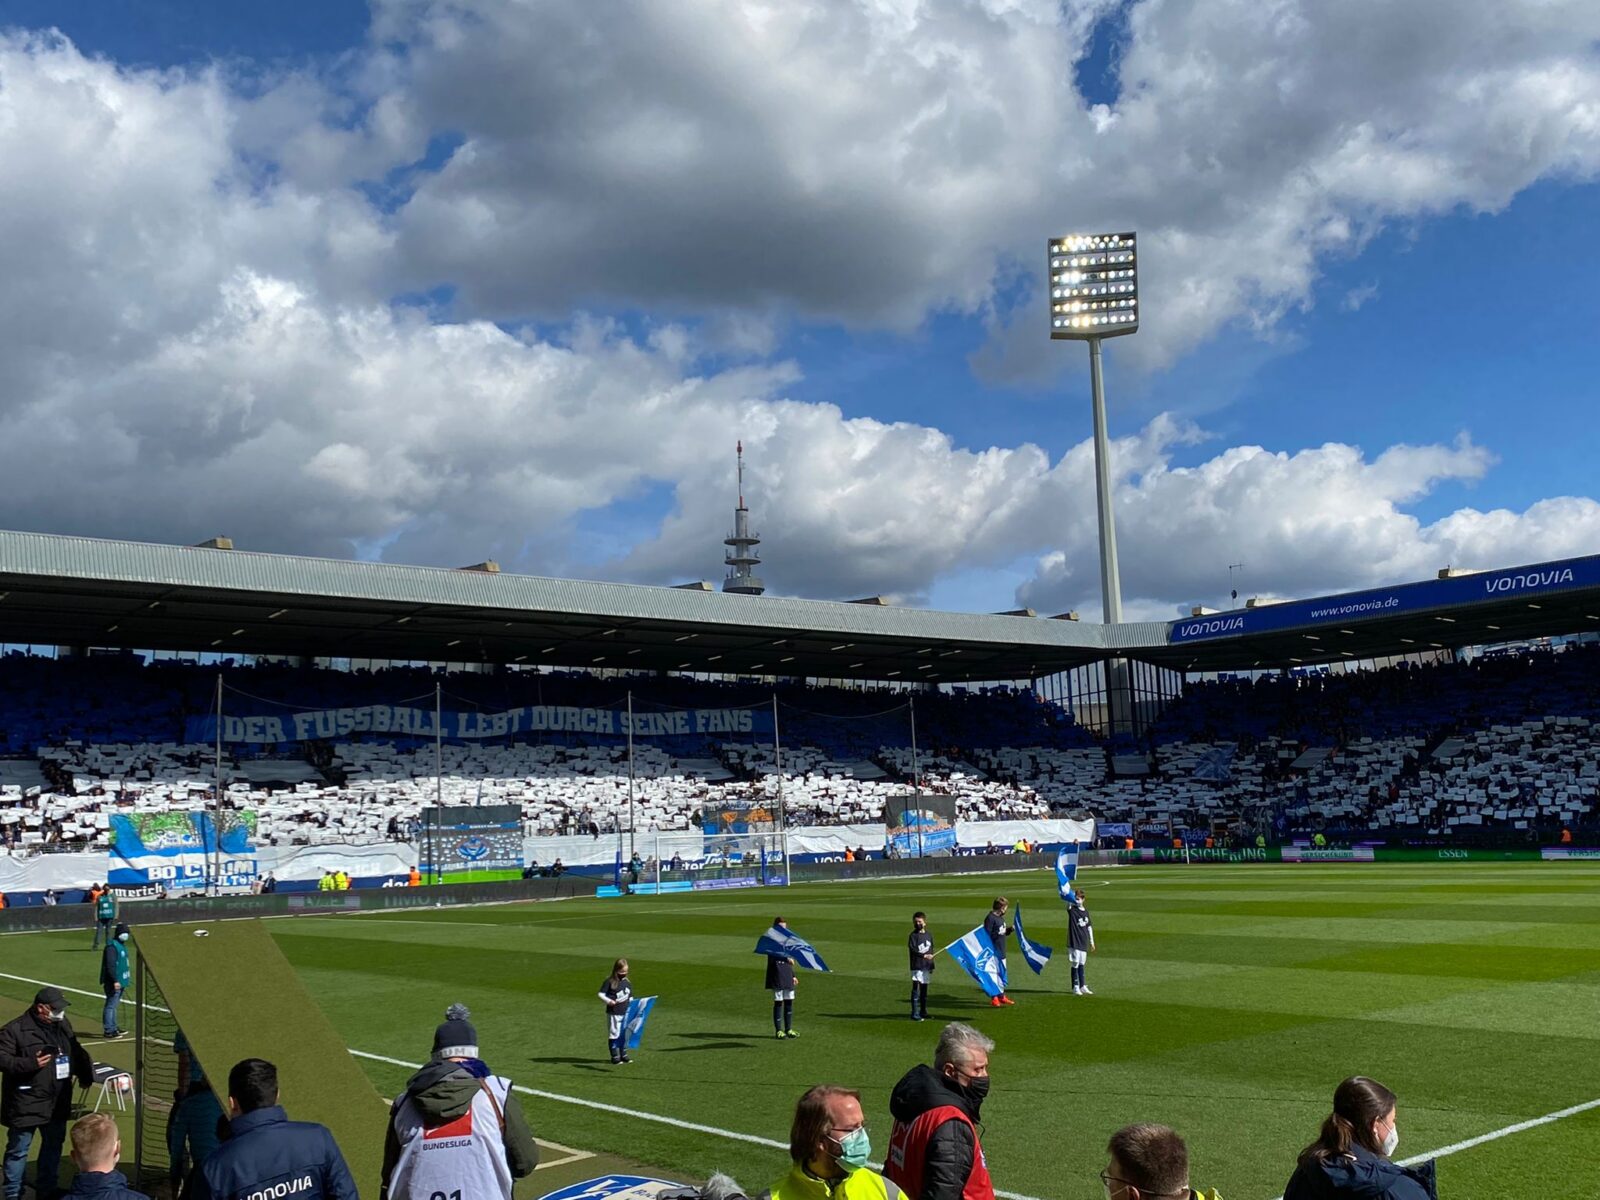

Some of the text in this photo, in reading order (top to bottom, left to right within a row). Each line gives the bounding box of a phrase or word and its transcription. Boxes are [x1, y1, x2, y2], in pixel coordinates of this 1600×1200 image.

[1485, 568, 1574, 593] VONOVIA
[1311, 597, 1399, 618] www.vonovia.de
[1181, 617, 1244, 637] VONOVIA
[223, 704, 753, 743] DER FUSSBALL LEBT DURCH SEINE FANS
[1438, 850, 1469, 858] ESSEN
[422, 1139, 472, 1150] BUNDESLIGA
[240, 1175, 313, 1200] ONOVIA
